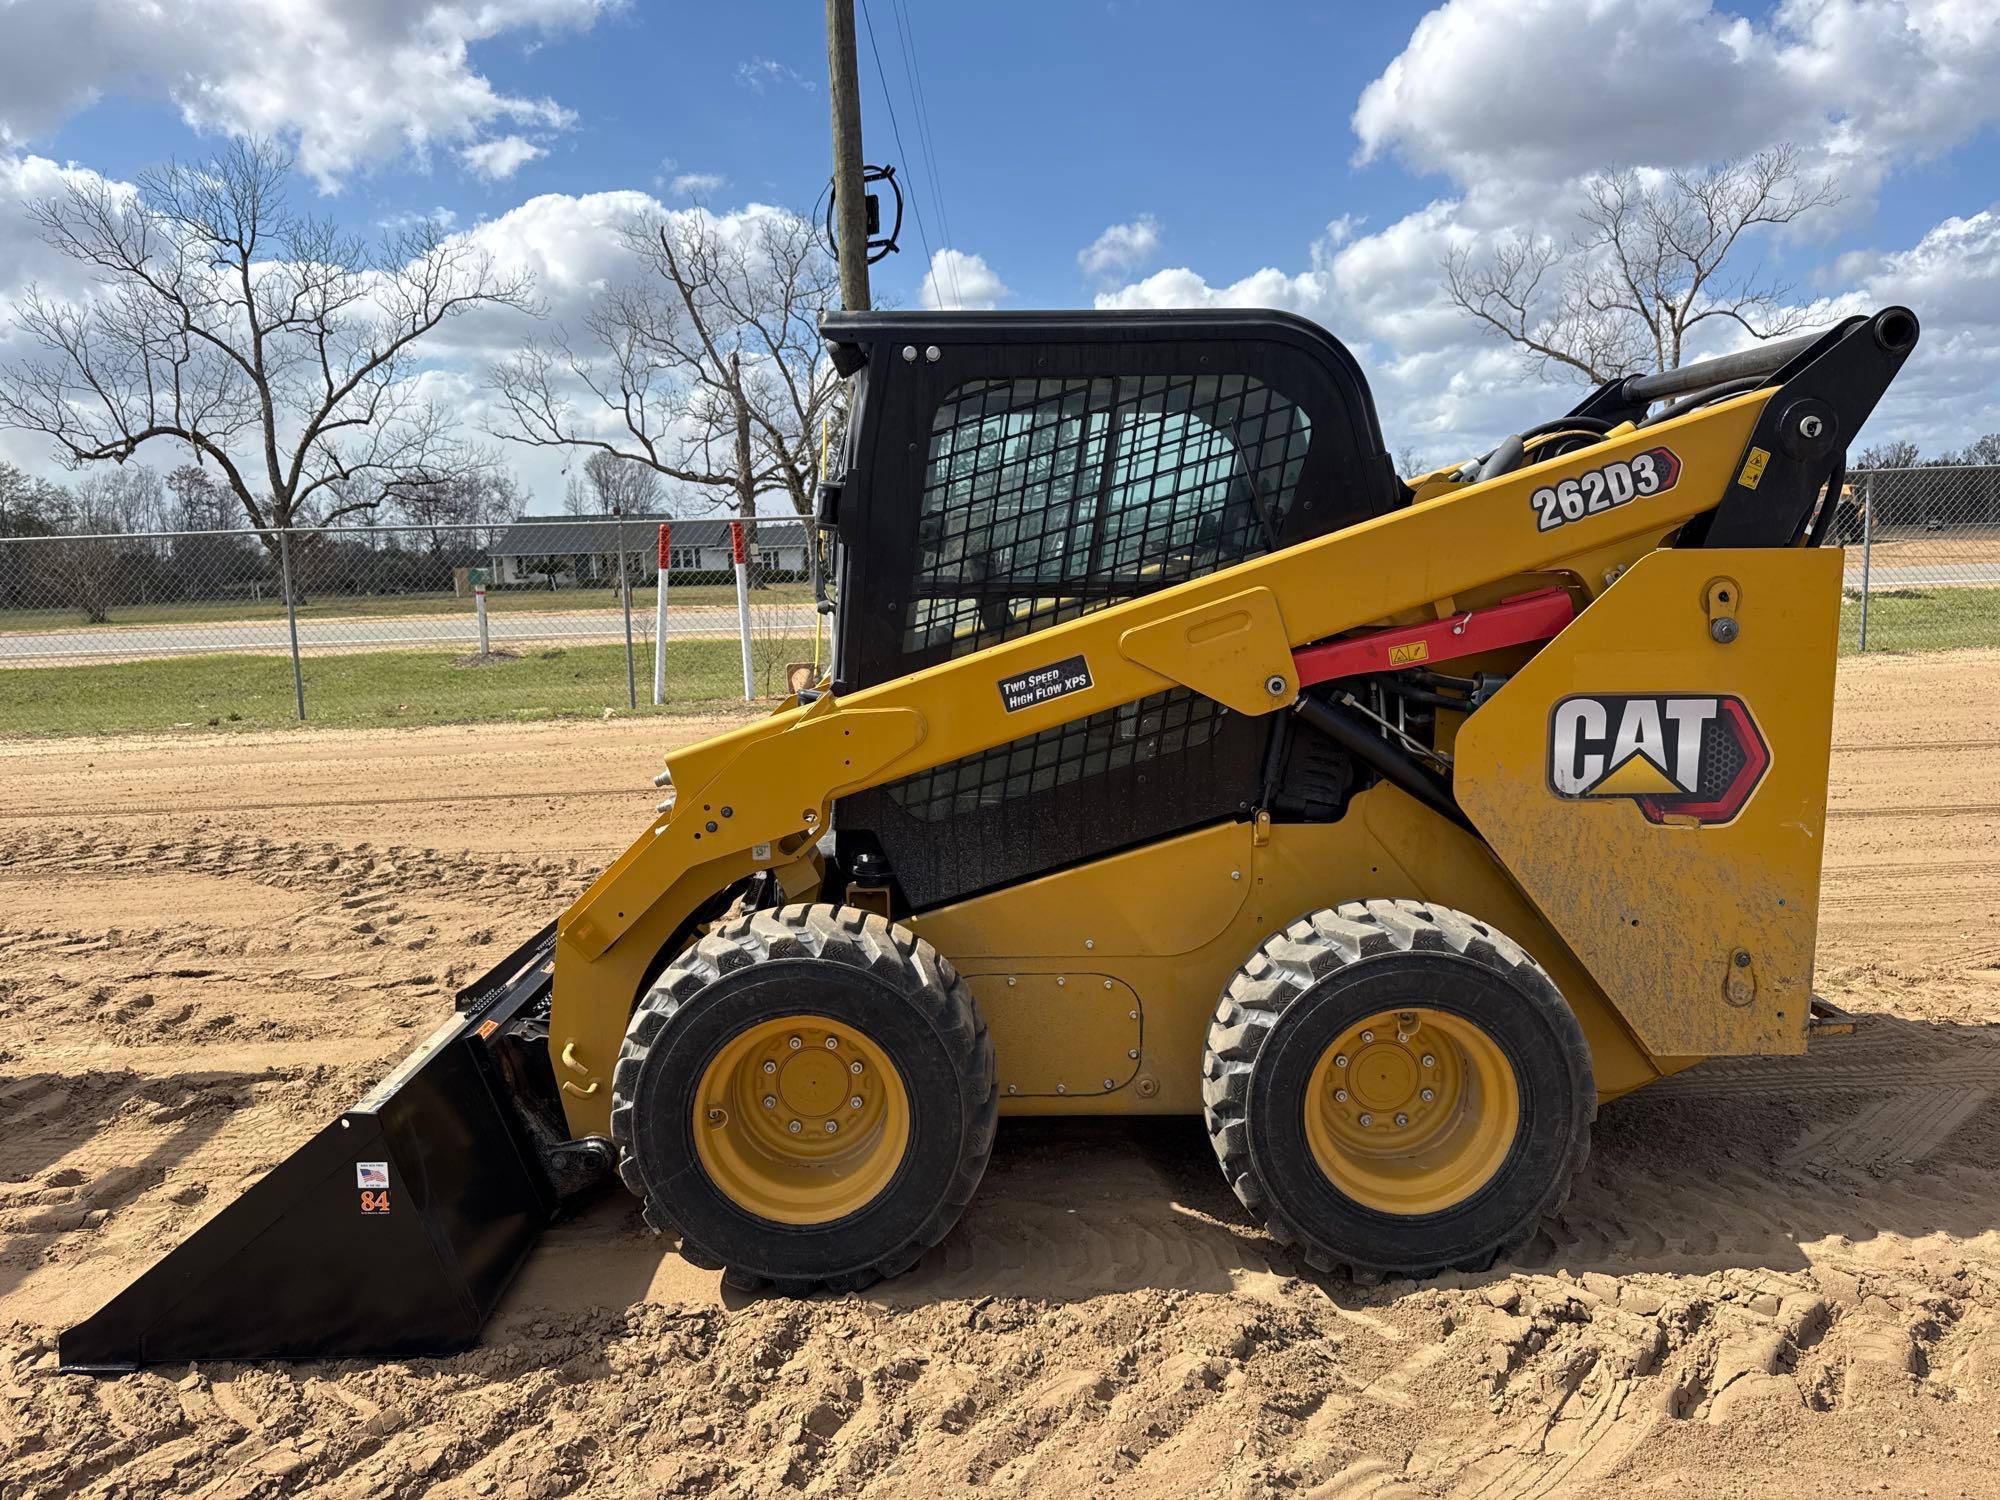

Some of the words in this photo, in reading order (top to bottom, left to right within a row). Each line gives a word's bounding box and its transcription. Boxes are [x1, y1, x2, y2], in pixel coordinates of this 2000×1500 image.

[1532, 454, 1660, 530] 262D3
[1003, 680, 1026, 695] TWO
[1028, 669, 1060, 687] SPEED
[1009, 693, 1034, 708] HIGH
[1036, 683, 1062, 700] FLOW
[1065, 674, 1087, 691] XPS
[1553, 698, 1718, 795] CAT
[361, 1190, 390, 1212] 84
